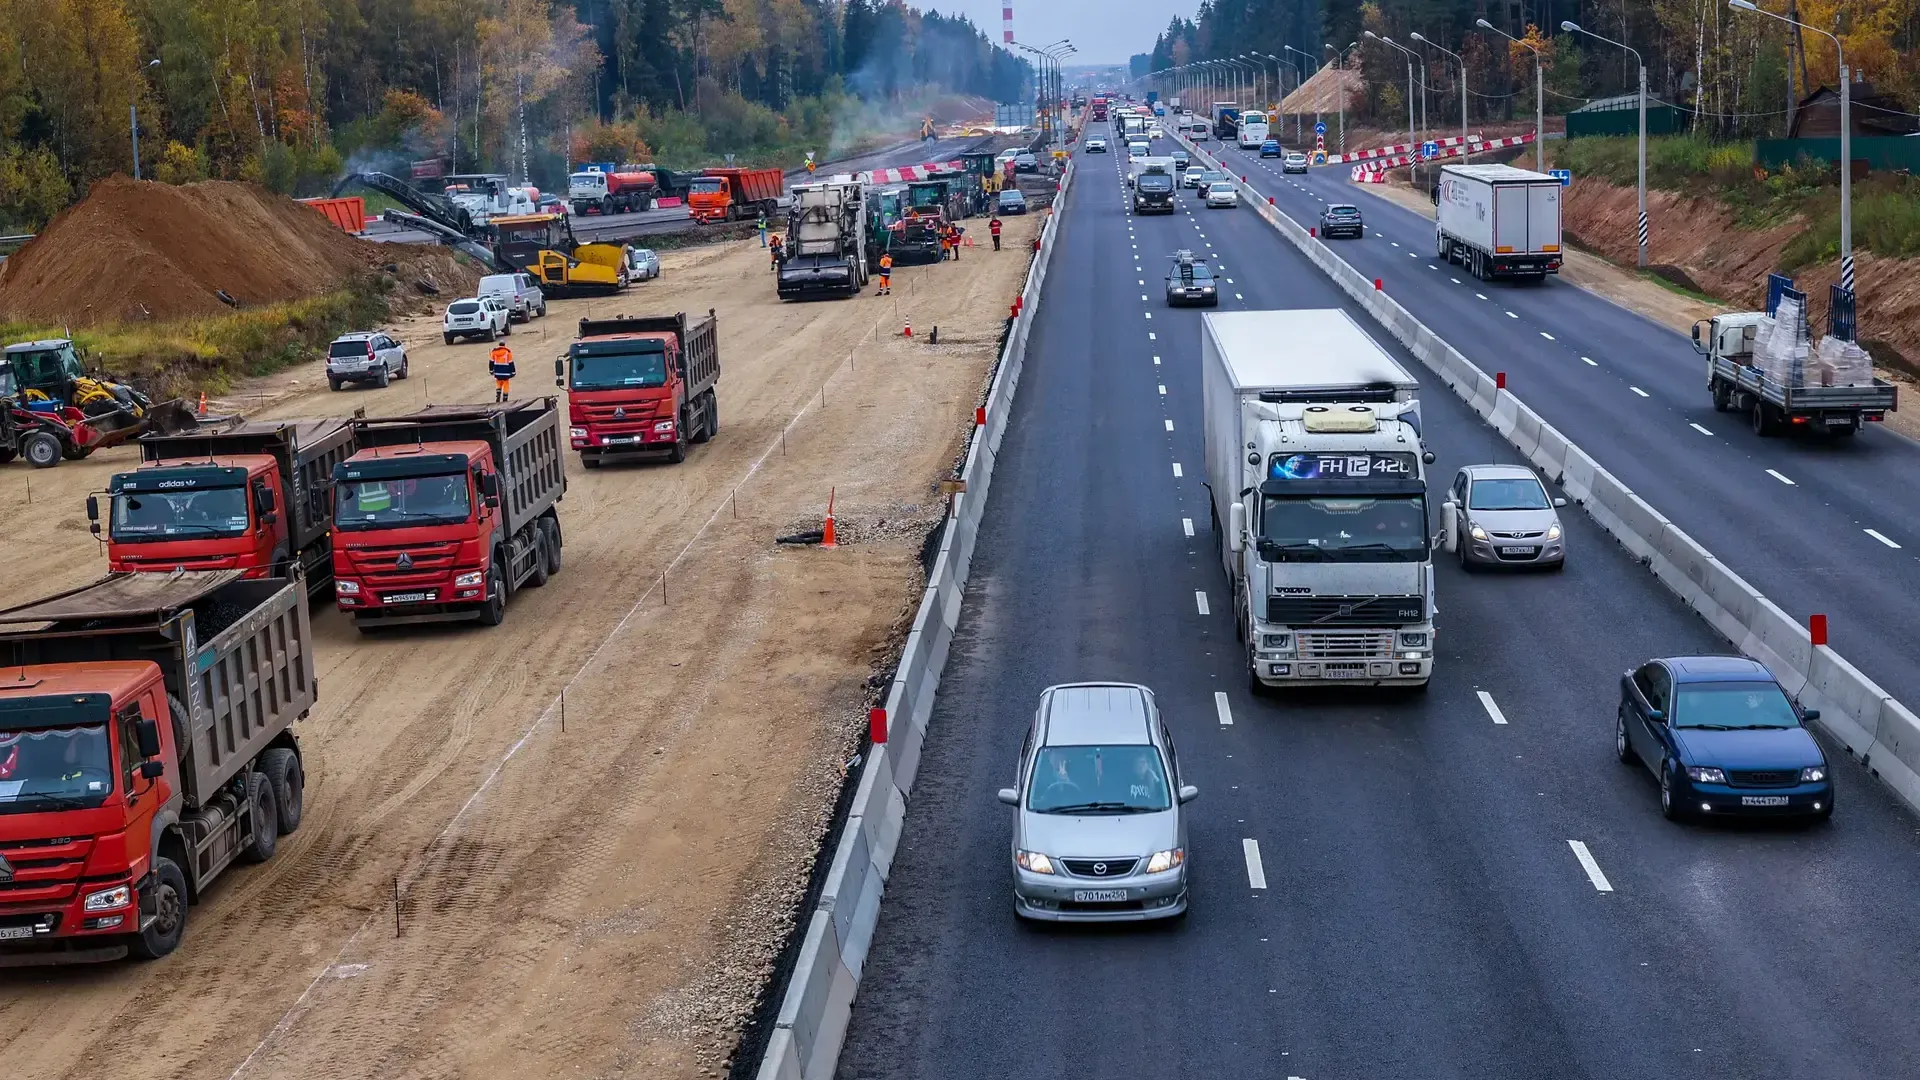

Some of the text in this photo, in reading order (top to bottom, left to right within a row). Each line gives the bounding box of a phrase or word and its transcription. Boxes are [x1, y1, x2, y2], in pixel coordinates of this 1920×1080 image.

[1320, 459, 1343, 472] FH
[1349, 459, 1368, 473] 12
[159, 480, 184, 488] adidas
[1275, 586, 1311, 594] VOLVO
[1398, 609, 1419, 617] FH12
